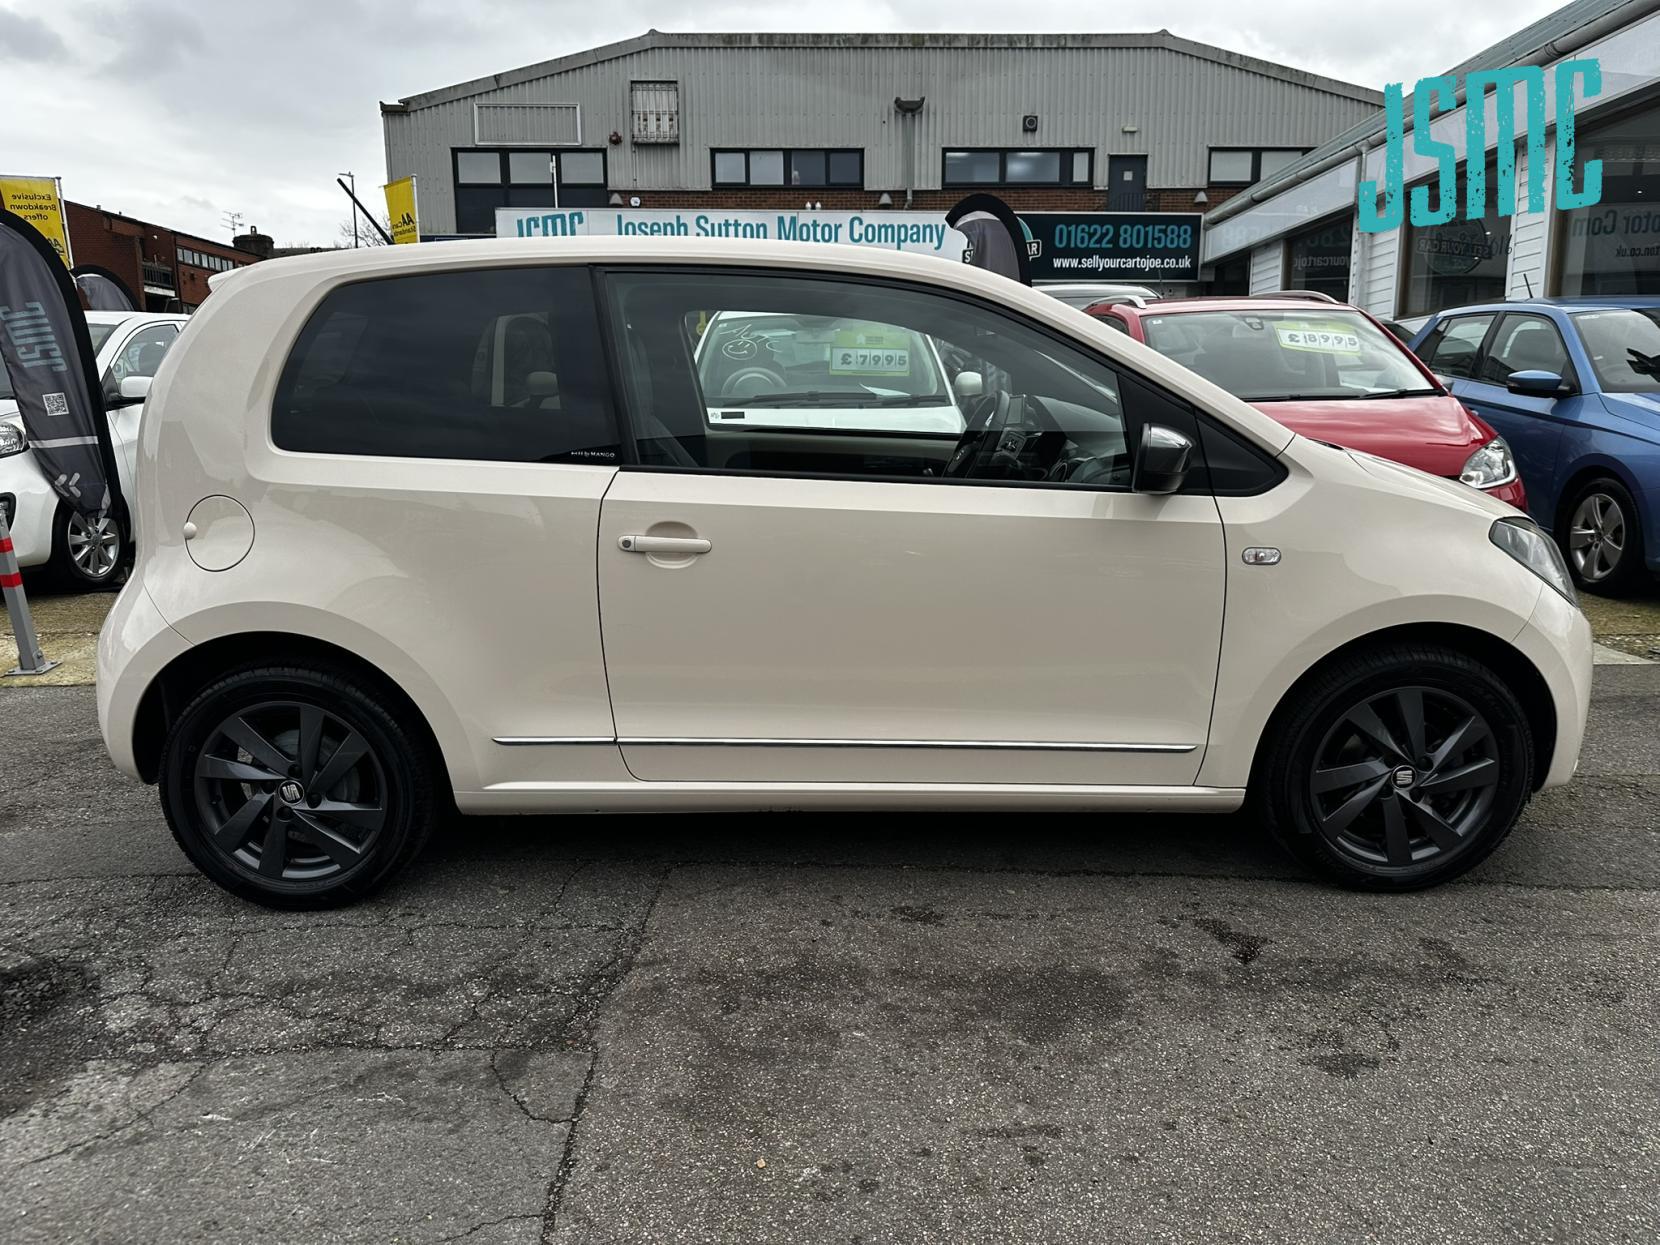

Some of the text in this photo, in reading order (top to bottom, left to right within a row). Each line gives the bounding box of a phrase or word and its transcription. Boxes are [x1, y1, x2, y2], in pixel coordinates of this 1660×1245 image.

[695, 215, 768, 240] Sutton
[777, 215, 842, 243] Motor
[849, 216, 947, 250] Company
[1054, 224, 1192, 249] 01622 801588
[1053, 255, 1192, 271] www.sellyourcartojoe.co.uk
[1287, 333, 1358, 347] £18995
[840, 352, 907, 366] £7995
